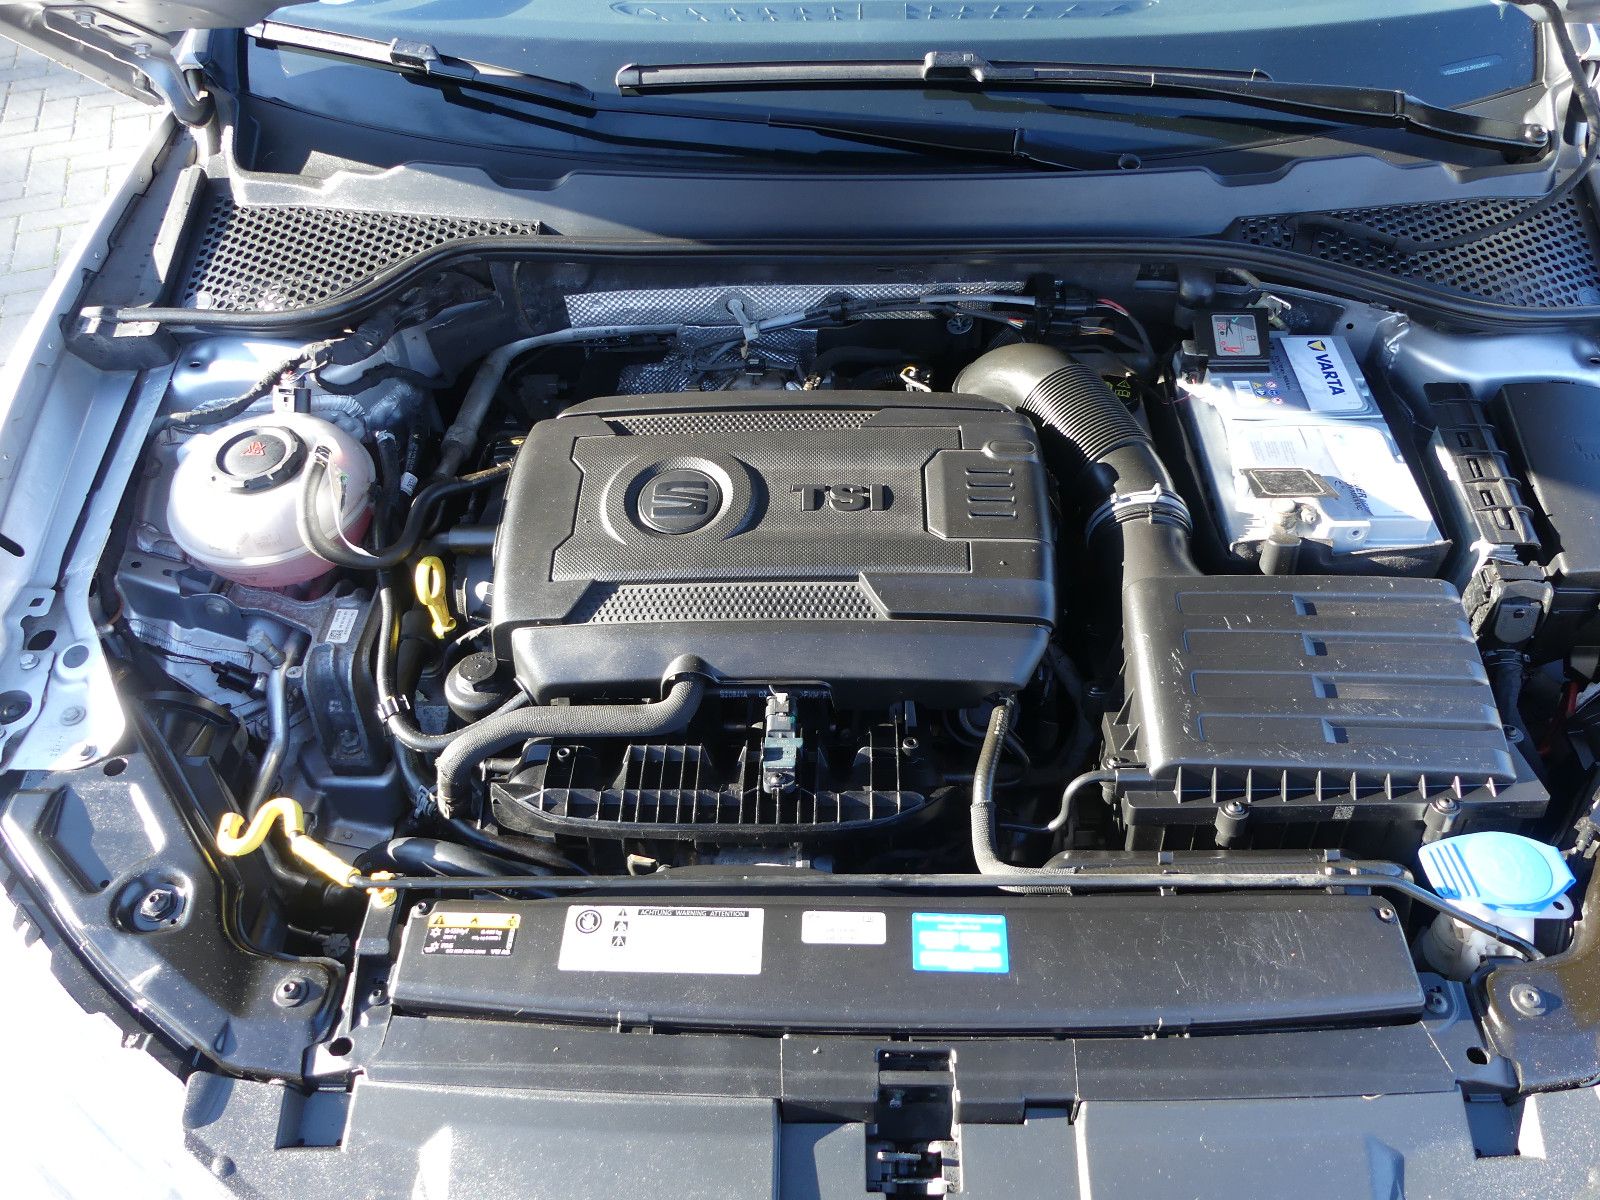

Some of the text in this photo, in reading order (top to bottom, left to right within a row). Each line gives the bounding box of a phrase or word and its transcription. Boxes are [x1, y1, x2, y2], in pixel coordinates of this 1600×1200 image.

[1315, 354, 1345, 396] VARTA
[790, 483, 886, 512] TSI
[640, 908, 672, 916] ACHTUNG
[675, 909, 707, 917] WARNING
